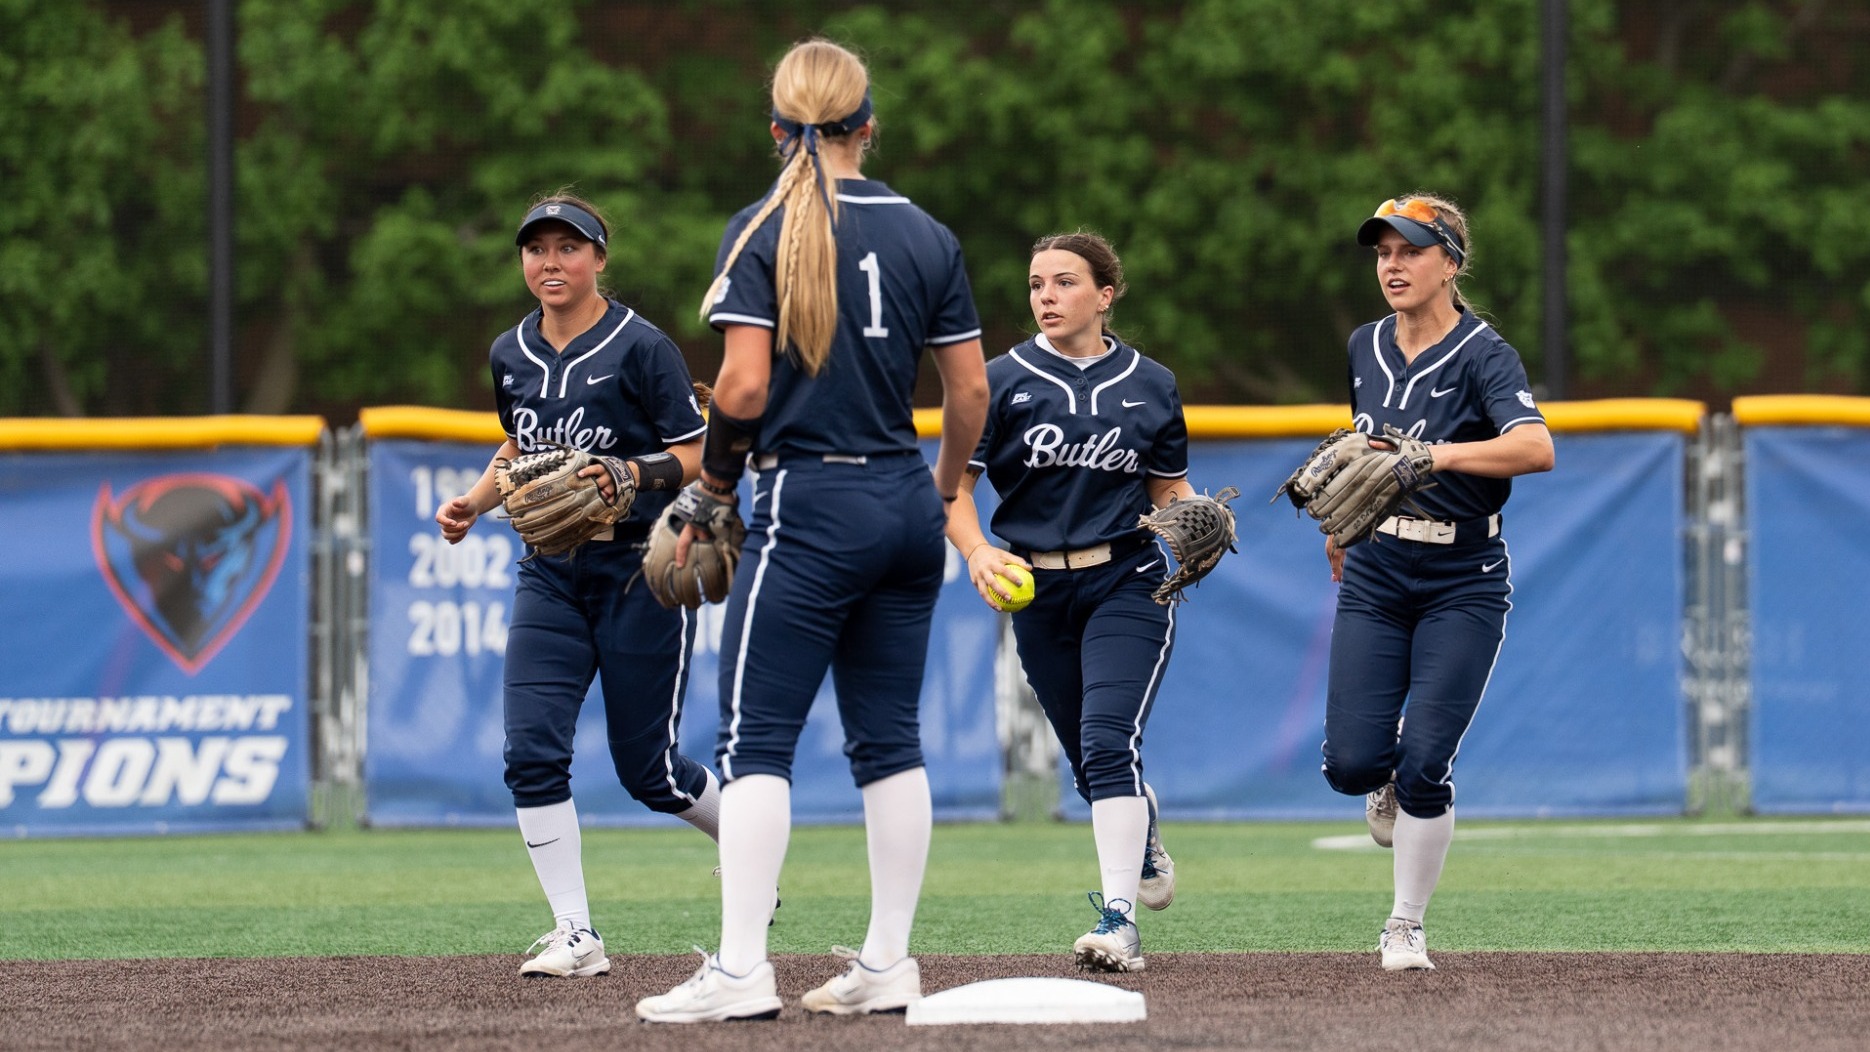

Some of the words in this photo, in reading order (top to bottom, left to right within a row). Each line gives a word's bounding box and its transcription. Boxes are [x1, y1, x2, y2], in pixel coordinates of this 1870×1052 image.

[858, 251, 889, 337] 1
[512, 406, 618, 452] Butler
[1023, 423, 1139, 473] Butler
[408, 532, 512, 589] 2002
[407, 601, 508, 657] 2014
[0, 736, 288, 808] PIONS
